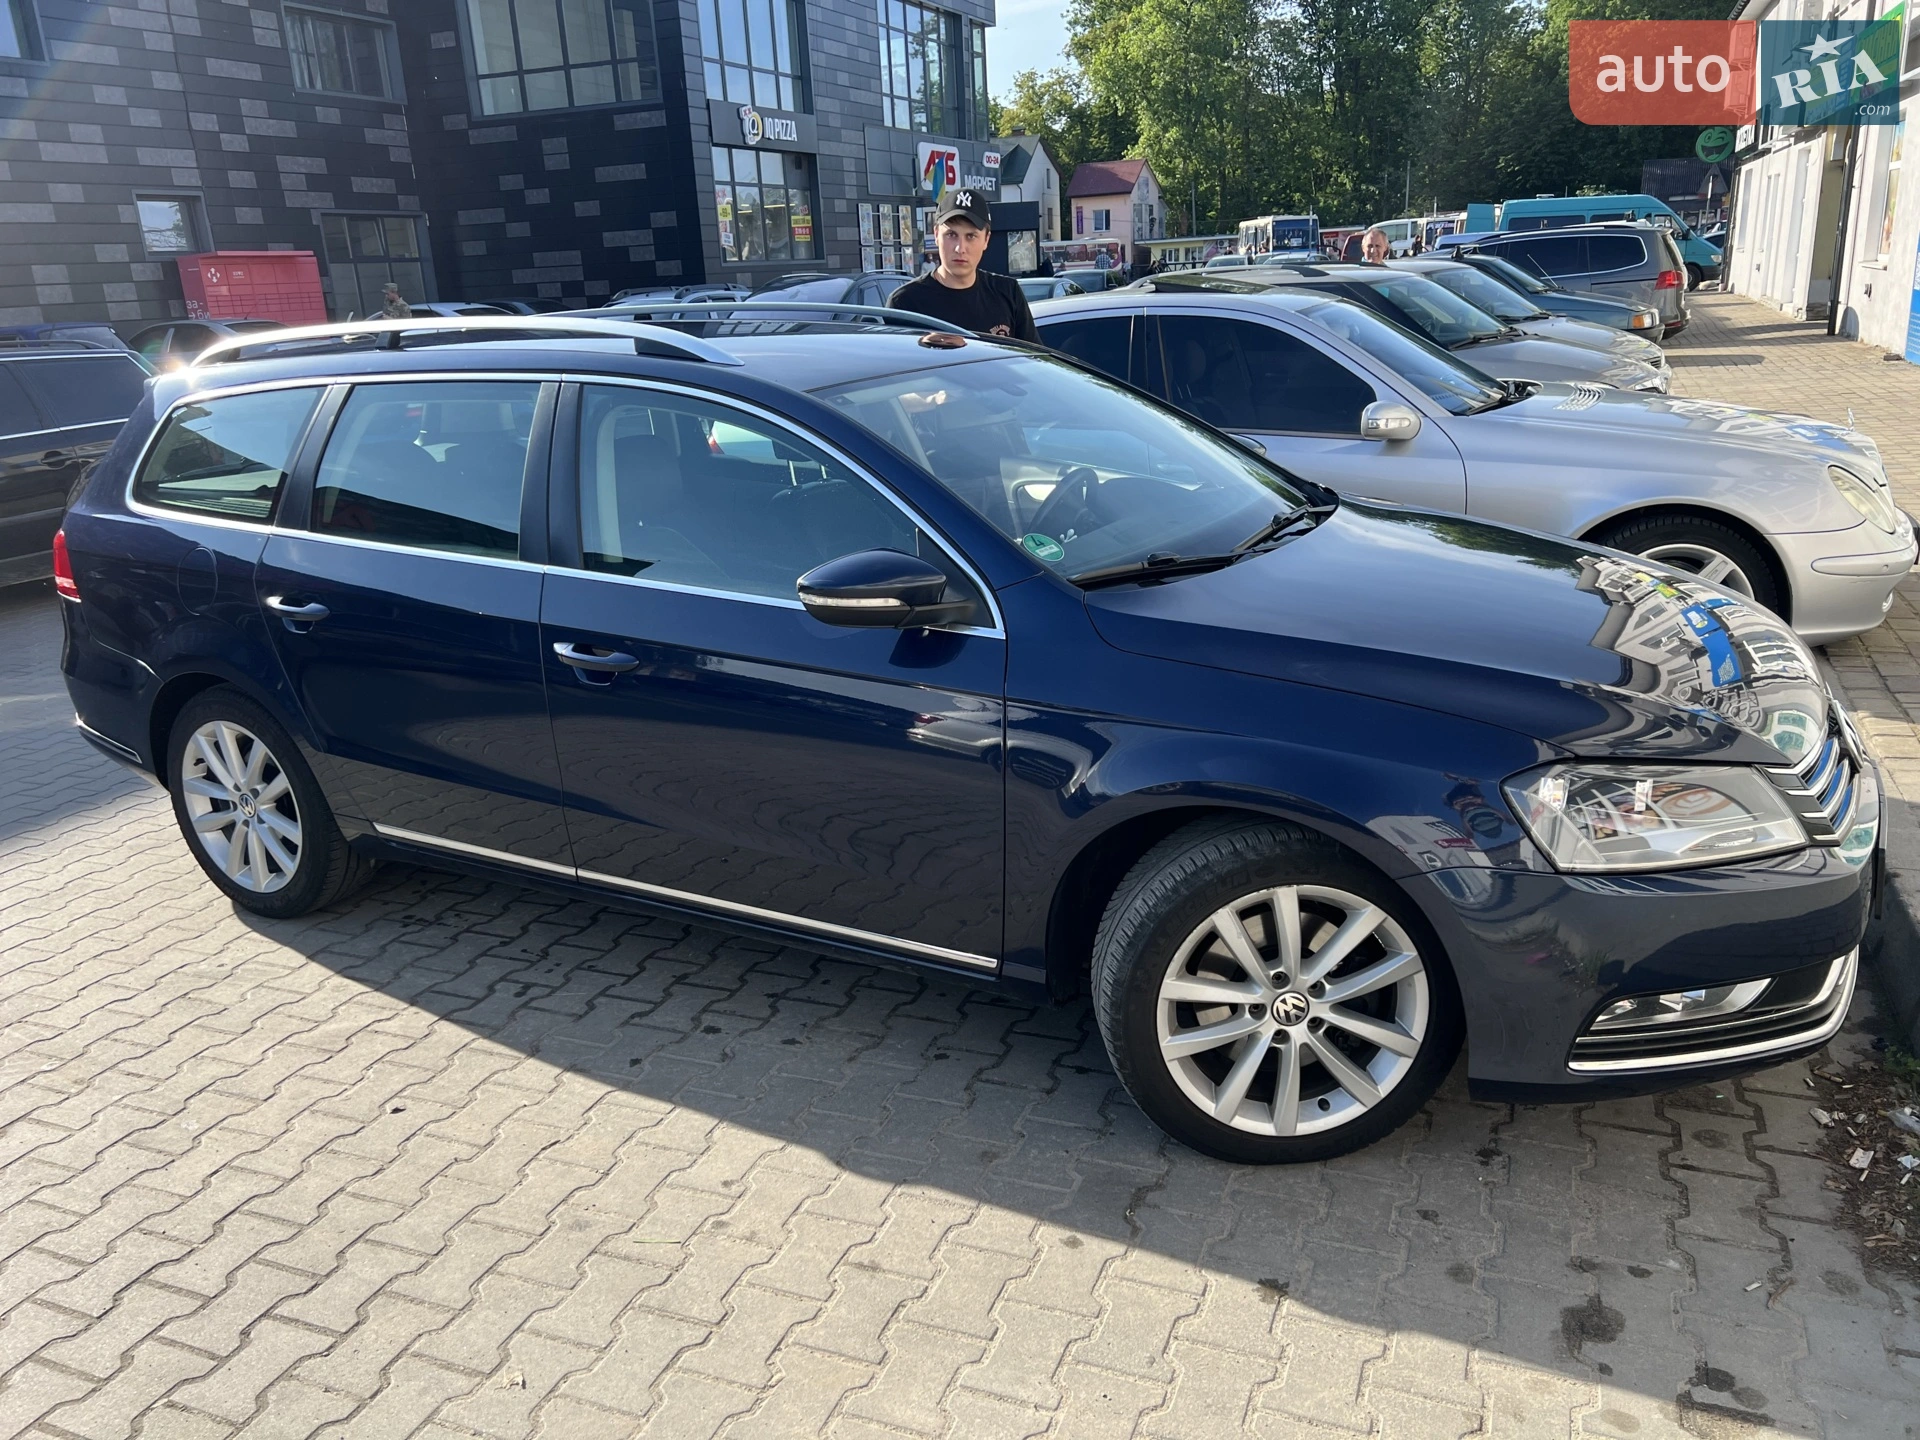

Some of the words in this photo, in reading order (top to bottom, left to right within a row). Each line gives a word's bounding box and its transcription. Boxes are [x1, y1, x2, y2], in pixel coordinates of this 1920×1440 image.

[763, 116, 775, 140] IQ
[775, 118, 797, 141] PIZZA
[985, 155, 999, 164] 00-24
[964, 174, 997, 192] МАРКЕТ
[956, 191, 972, 207] NY
